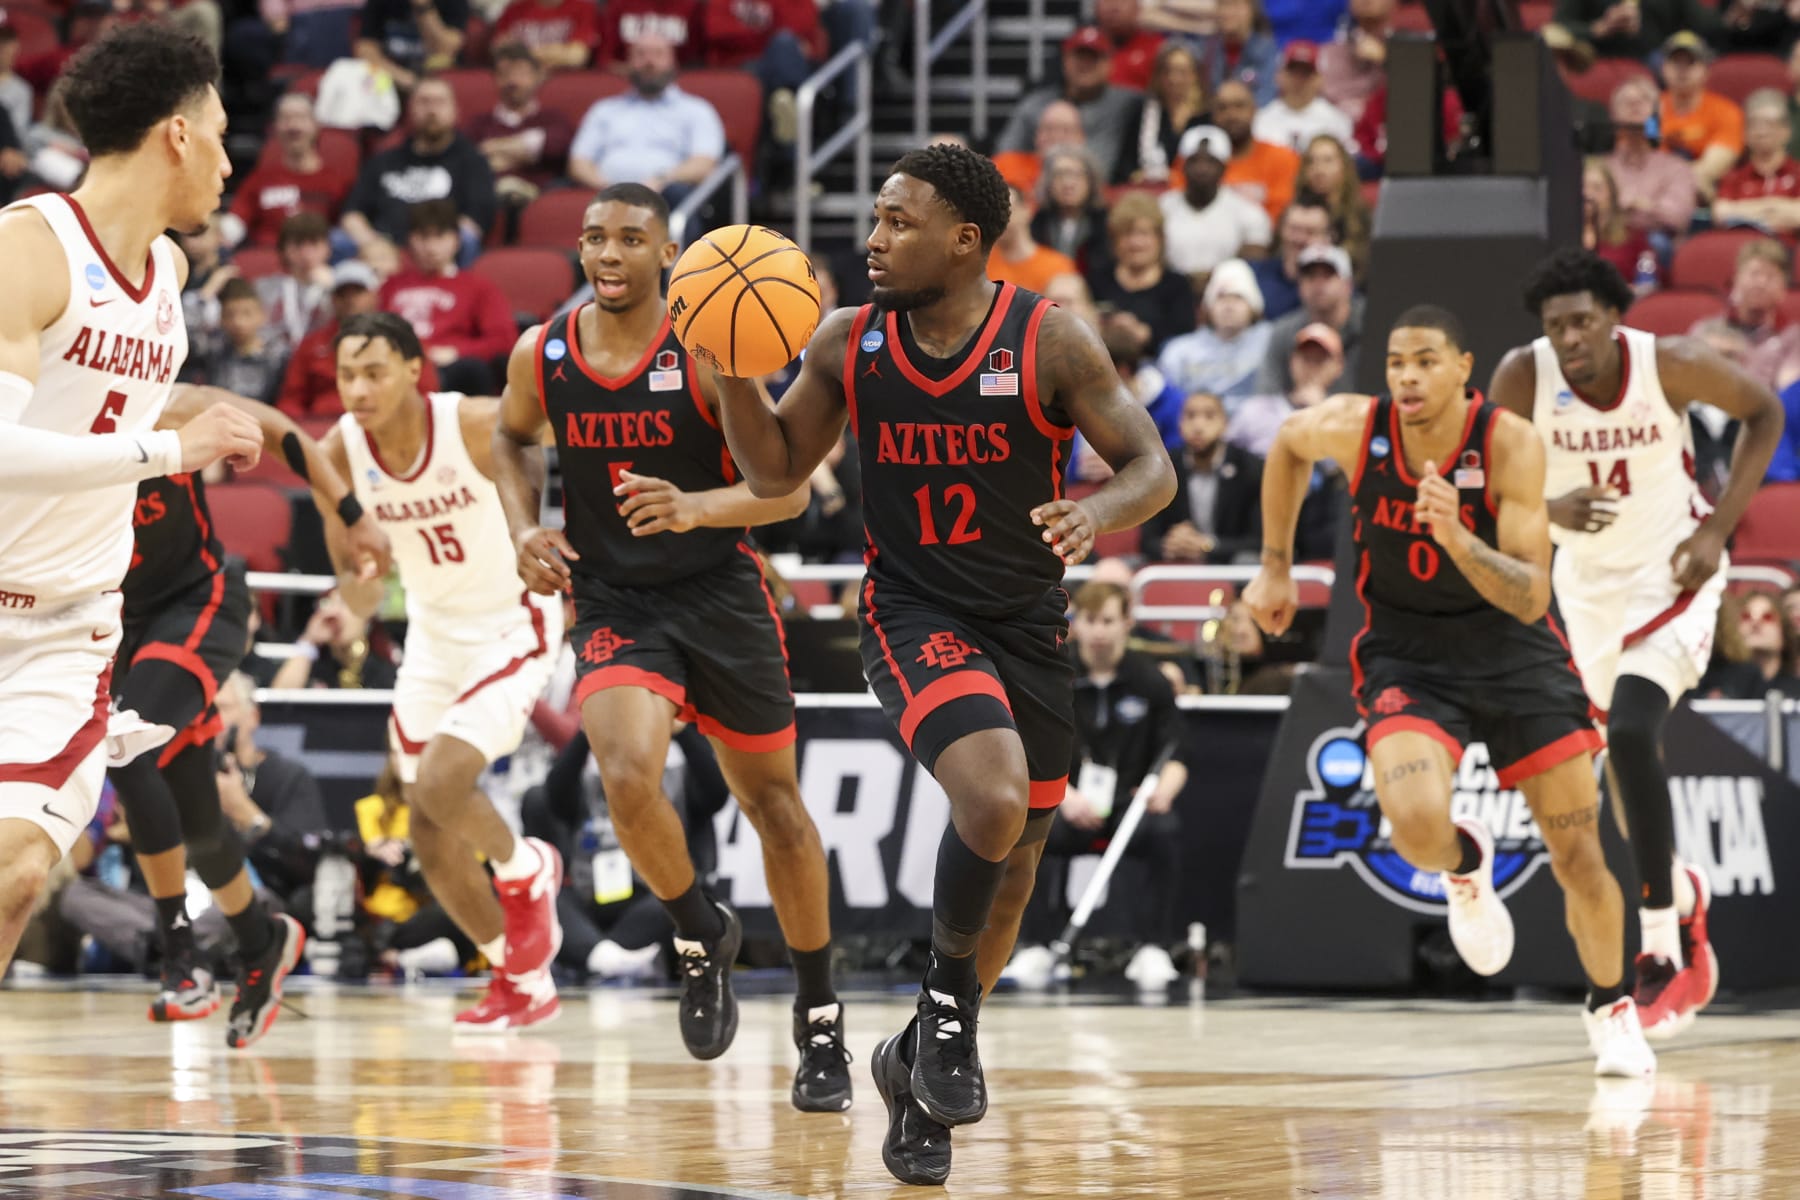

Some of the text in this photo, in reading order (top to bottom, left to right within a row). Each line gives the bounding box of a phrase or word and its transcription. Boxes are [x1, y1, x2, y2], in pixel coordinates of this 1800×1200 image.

[62, 326, 174, 384] ALABAMA
[566, 409, 674, 447] AZTECS
[877, 422, 1011, 465] AZTECS
[1553, 424, 1662, 452] ALABAMA
[1587, 459, 1631, 497] 14
[375, 486, 477, 522] ALABAMA
[912, 483, 982, 545] 12
[417, 522, 465, 566] 15
[1407, 540, 1440, 582] 0
[1384, 758, 1432, 785] LOVE
[1667, 775, 1775, 897] NCAA
